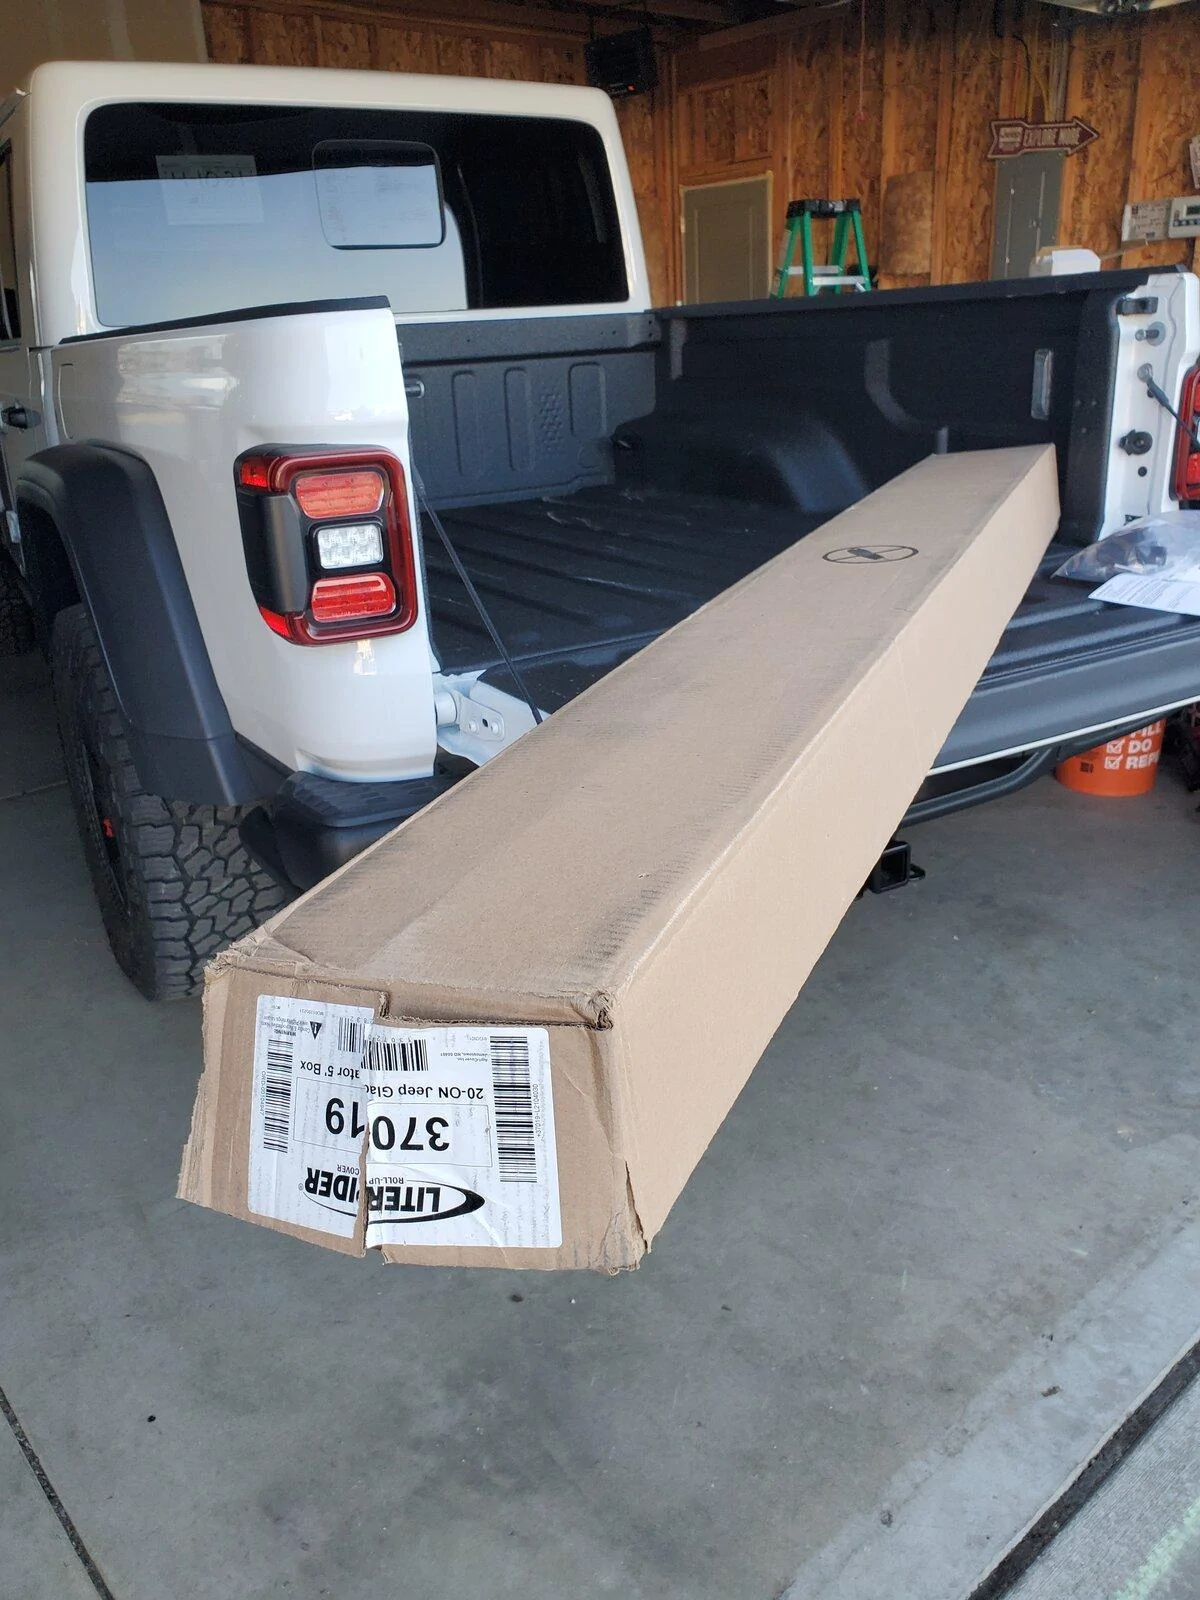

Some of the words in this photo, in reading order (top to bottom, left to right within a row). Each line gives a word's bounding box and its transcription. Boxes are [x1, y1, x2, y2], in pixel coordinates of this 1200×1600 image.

[1128, 738, 1153, 754] DO
[300, 1060, 322, 1075] Box
[398, 1084, 433, 1099] Jeep
[438, 1084, 484, 1100] 20-ON
[324, 1098, 450, 1152] 37019
[336, 1164, 360, 1176] COVER
[368, 1176, 404, 1186] ROLL-UP
